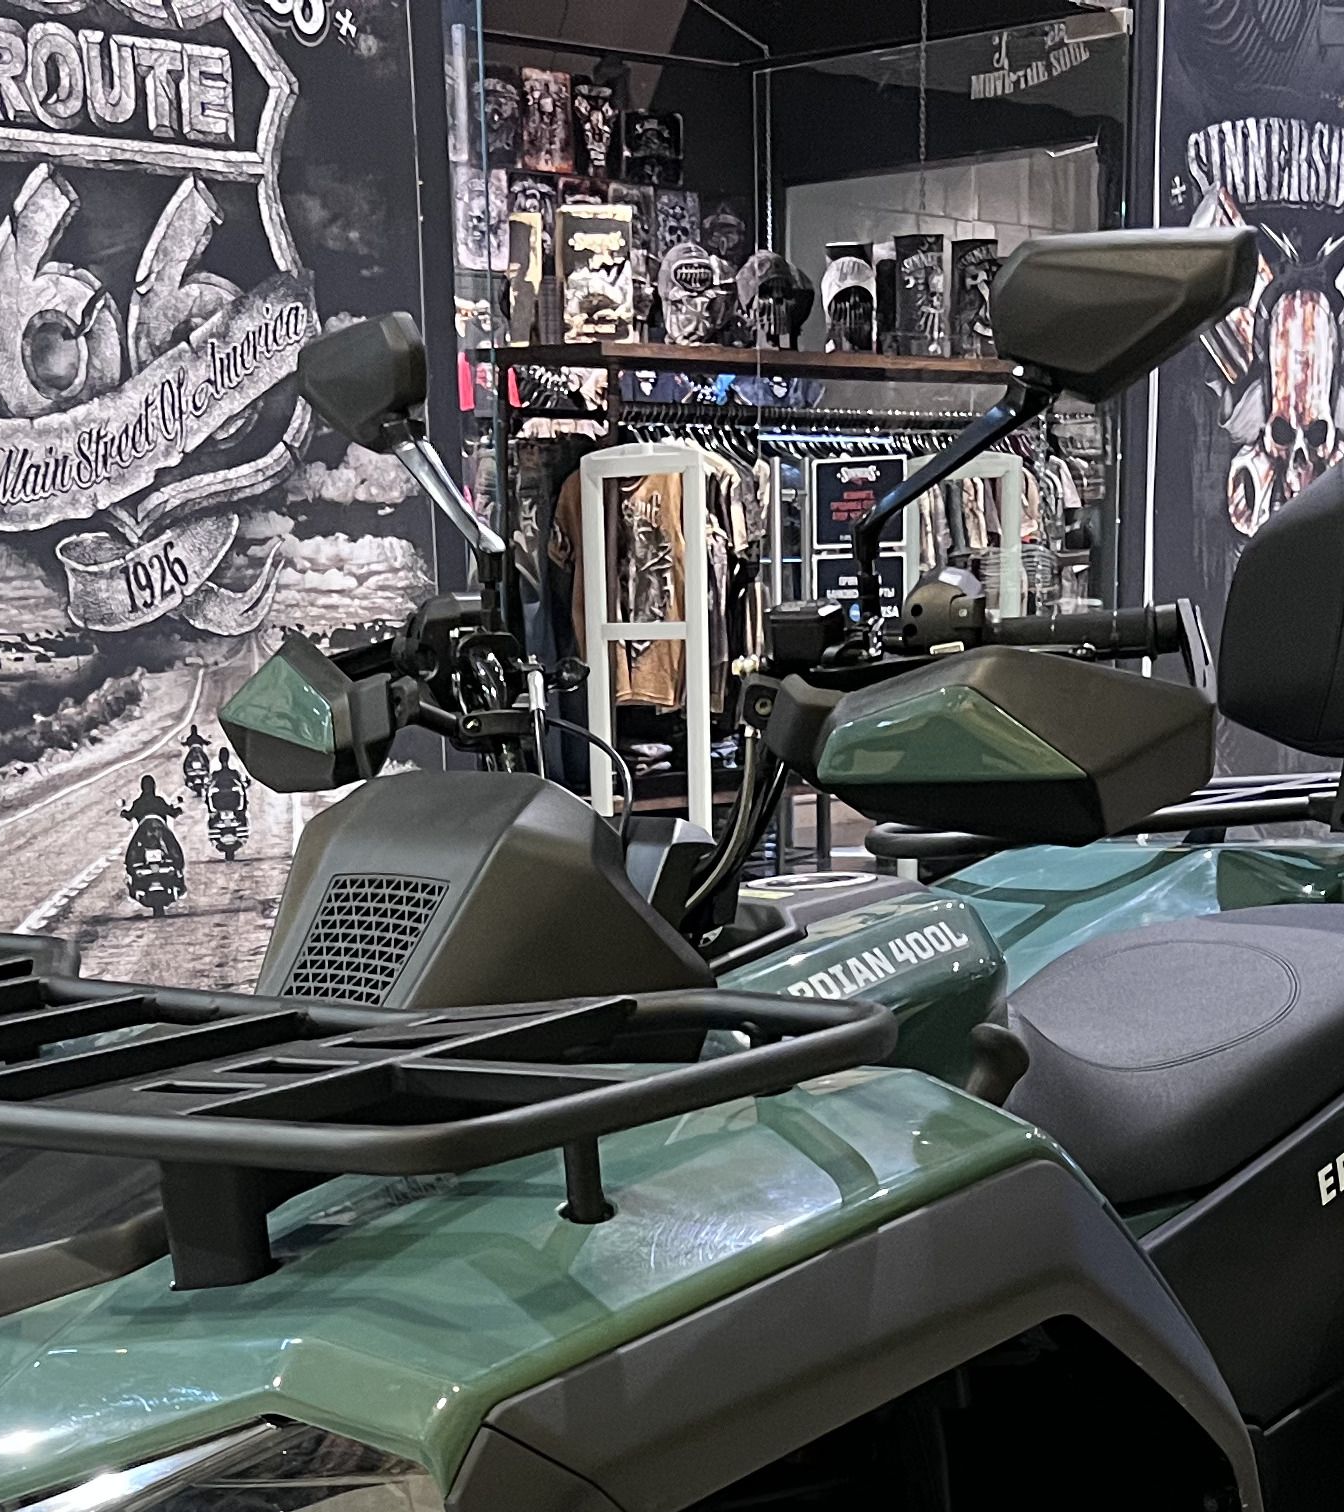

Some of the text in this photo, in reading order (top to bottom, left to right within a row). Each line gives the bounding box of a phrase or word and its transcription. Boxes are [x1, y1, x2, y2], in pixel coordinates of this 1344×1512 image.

[1017, 61, 1049, 89] THE
[1050, 41, 1090, 76] SOUL
[76, 396, 157, 488] Street
[160, 367, 188, 447] Of
[193, 302, 306, 417] America
[119, 541, 188, 613] 1926
[888, 921, 969, 964] 400L
